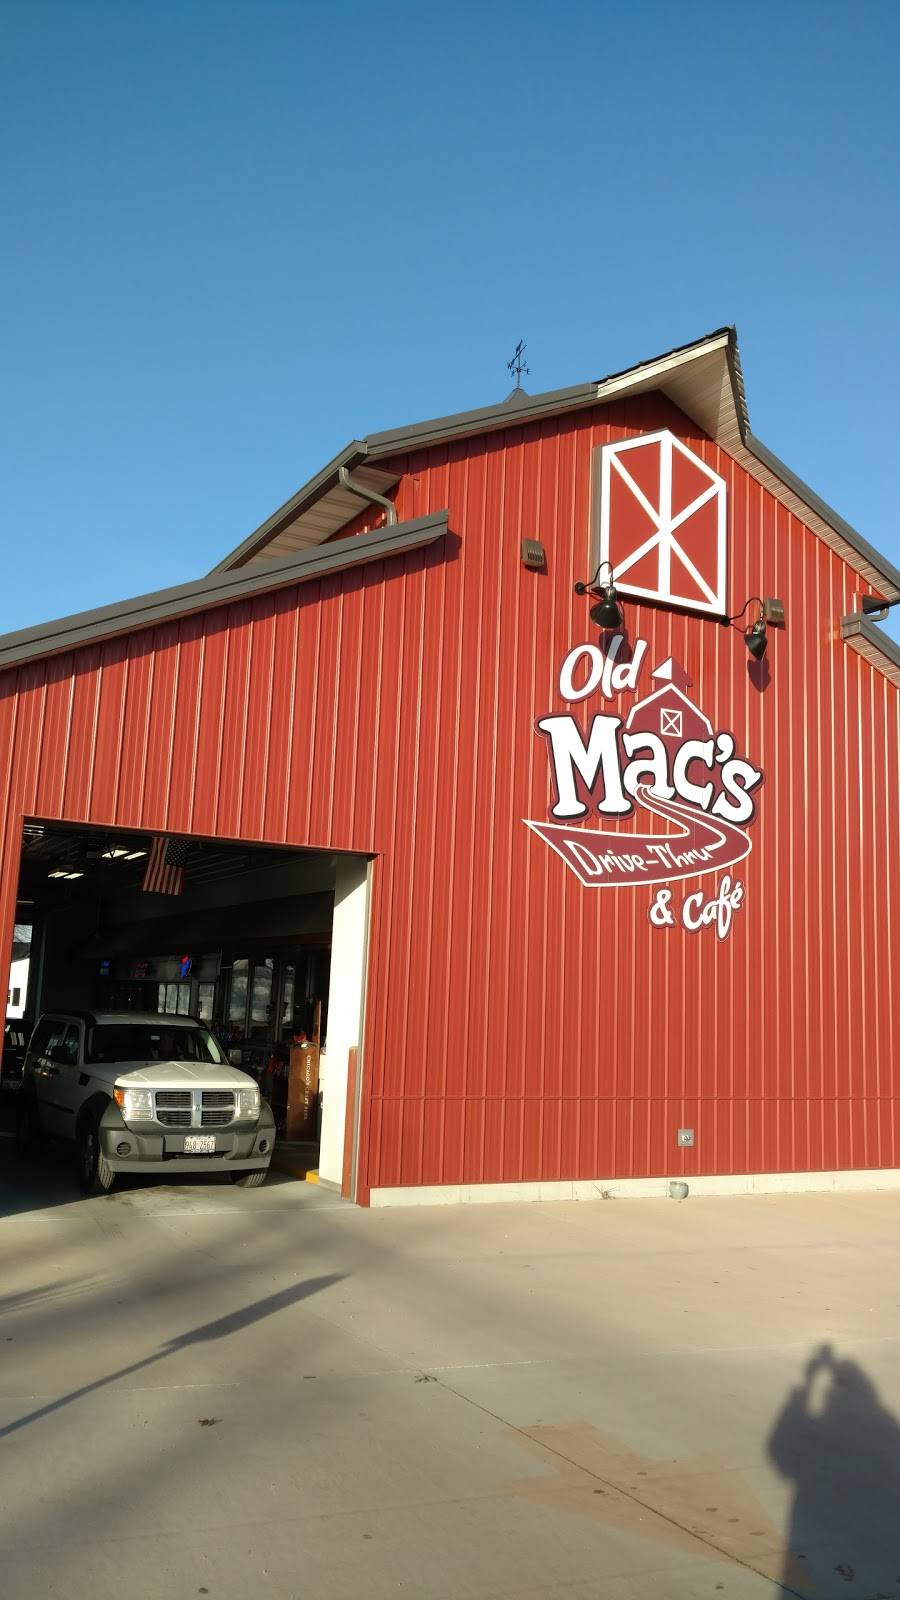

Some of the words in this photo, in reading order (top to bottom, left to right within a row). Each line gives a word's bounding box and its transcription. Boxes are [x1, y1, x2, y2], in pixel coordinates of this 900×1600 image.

[559, 635, 647, 700] Old
[538, 714, 761, 823] Mac's
[563, 840, 712, 876] Drive-Thru
[650, 889, 674, 924] &
[683, 875, 743, 939] Café
